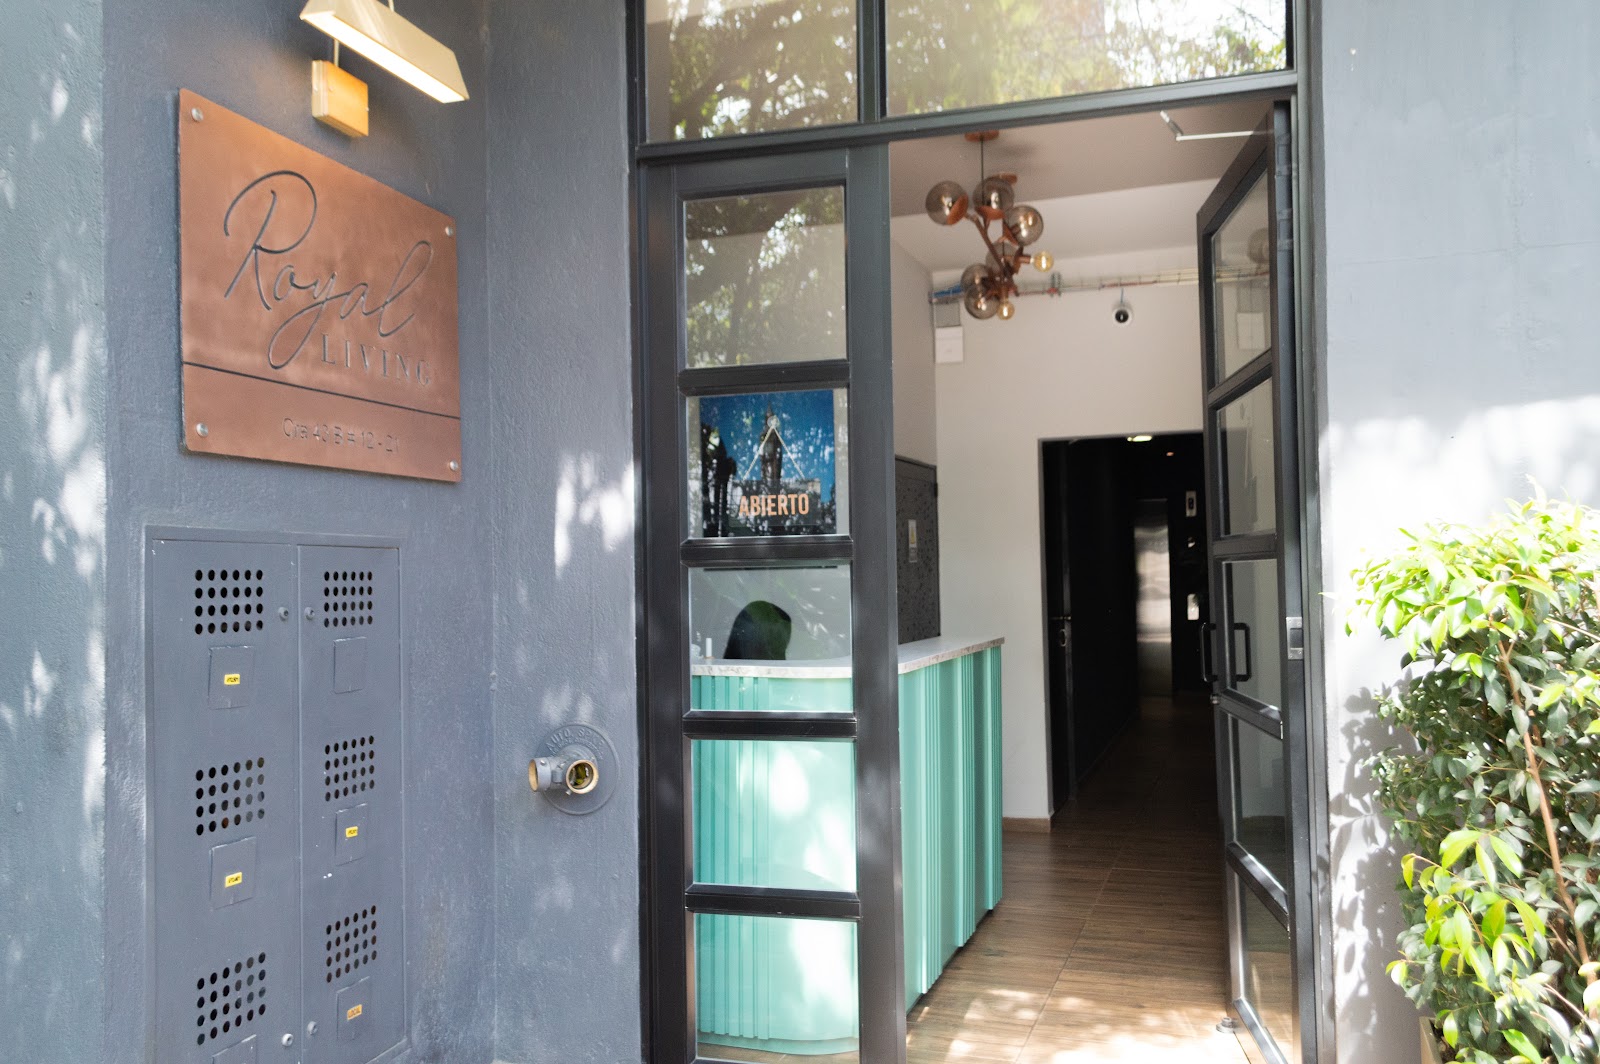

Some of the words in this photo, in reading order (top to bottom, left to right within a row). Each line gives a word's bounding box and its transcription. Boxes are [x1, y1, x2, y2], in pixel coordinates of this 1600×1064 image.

[223, 170, 434, 370] Royal
[321, 333, 430, 387] LIVING
[282, 417, 307, 439] Cra
[738, 494, 809, 516] ABIERTO
